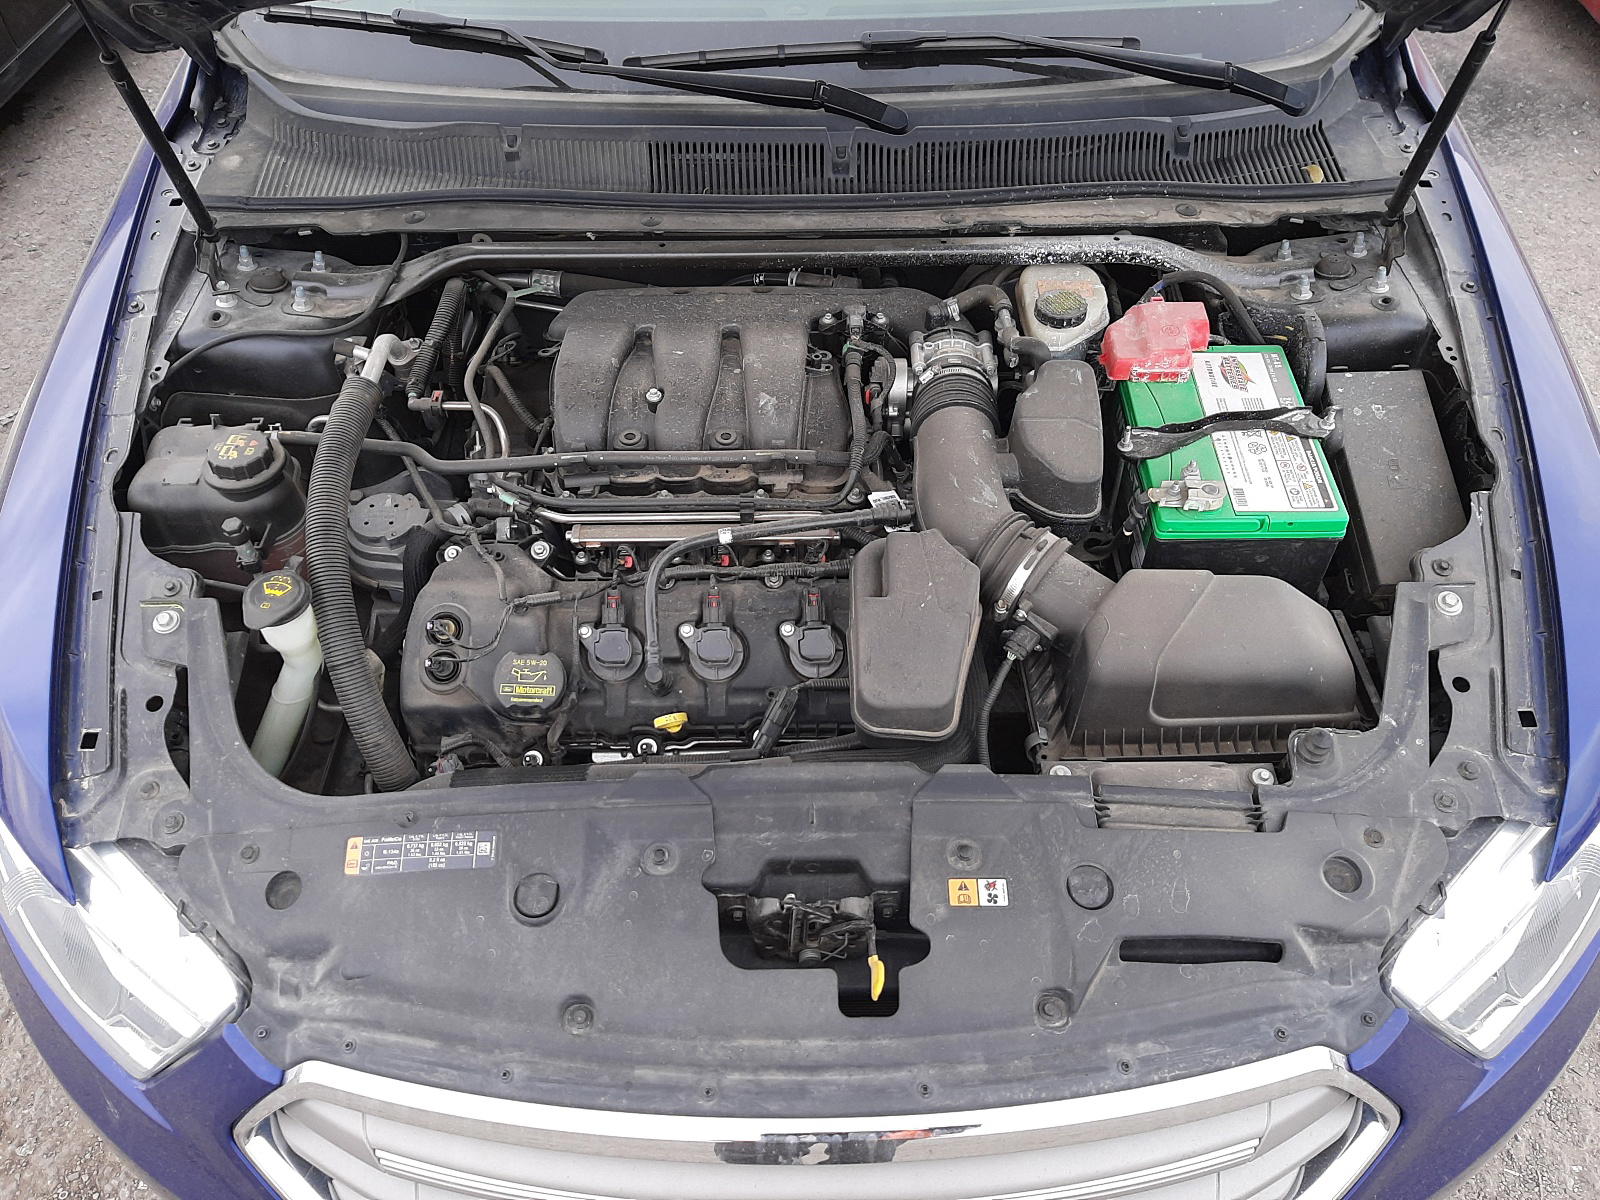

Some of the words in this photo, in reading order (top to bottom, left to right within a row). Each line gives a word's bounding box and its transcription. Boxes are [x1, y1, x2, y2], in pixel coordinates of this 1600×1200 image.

[1204, 360, 1219, 388] AUTOMOTIVE
[1221, 355, 1241, 391] BATTERIES
[1228, 355, 1249, 393] INTERSTATE
[515, 686, 552, 695] Motorcraft
